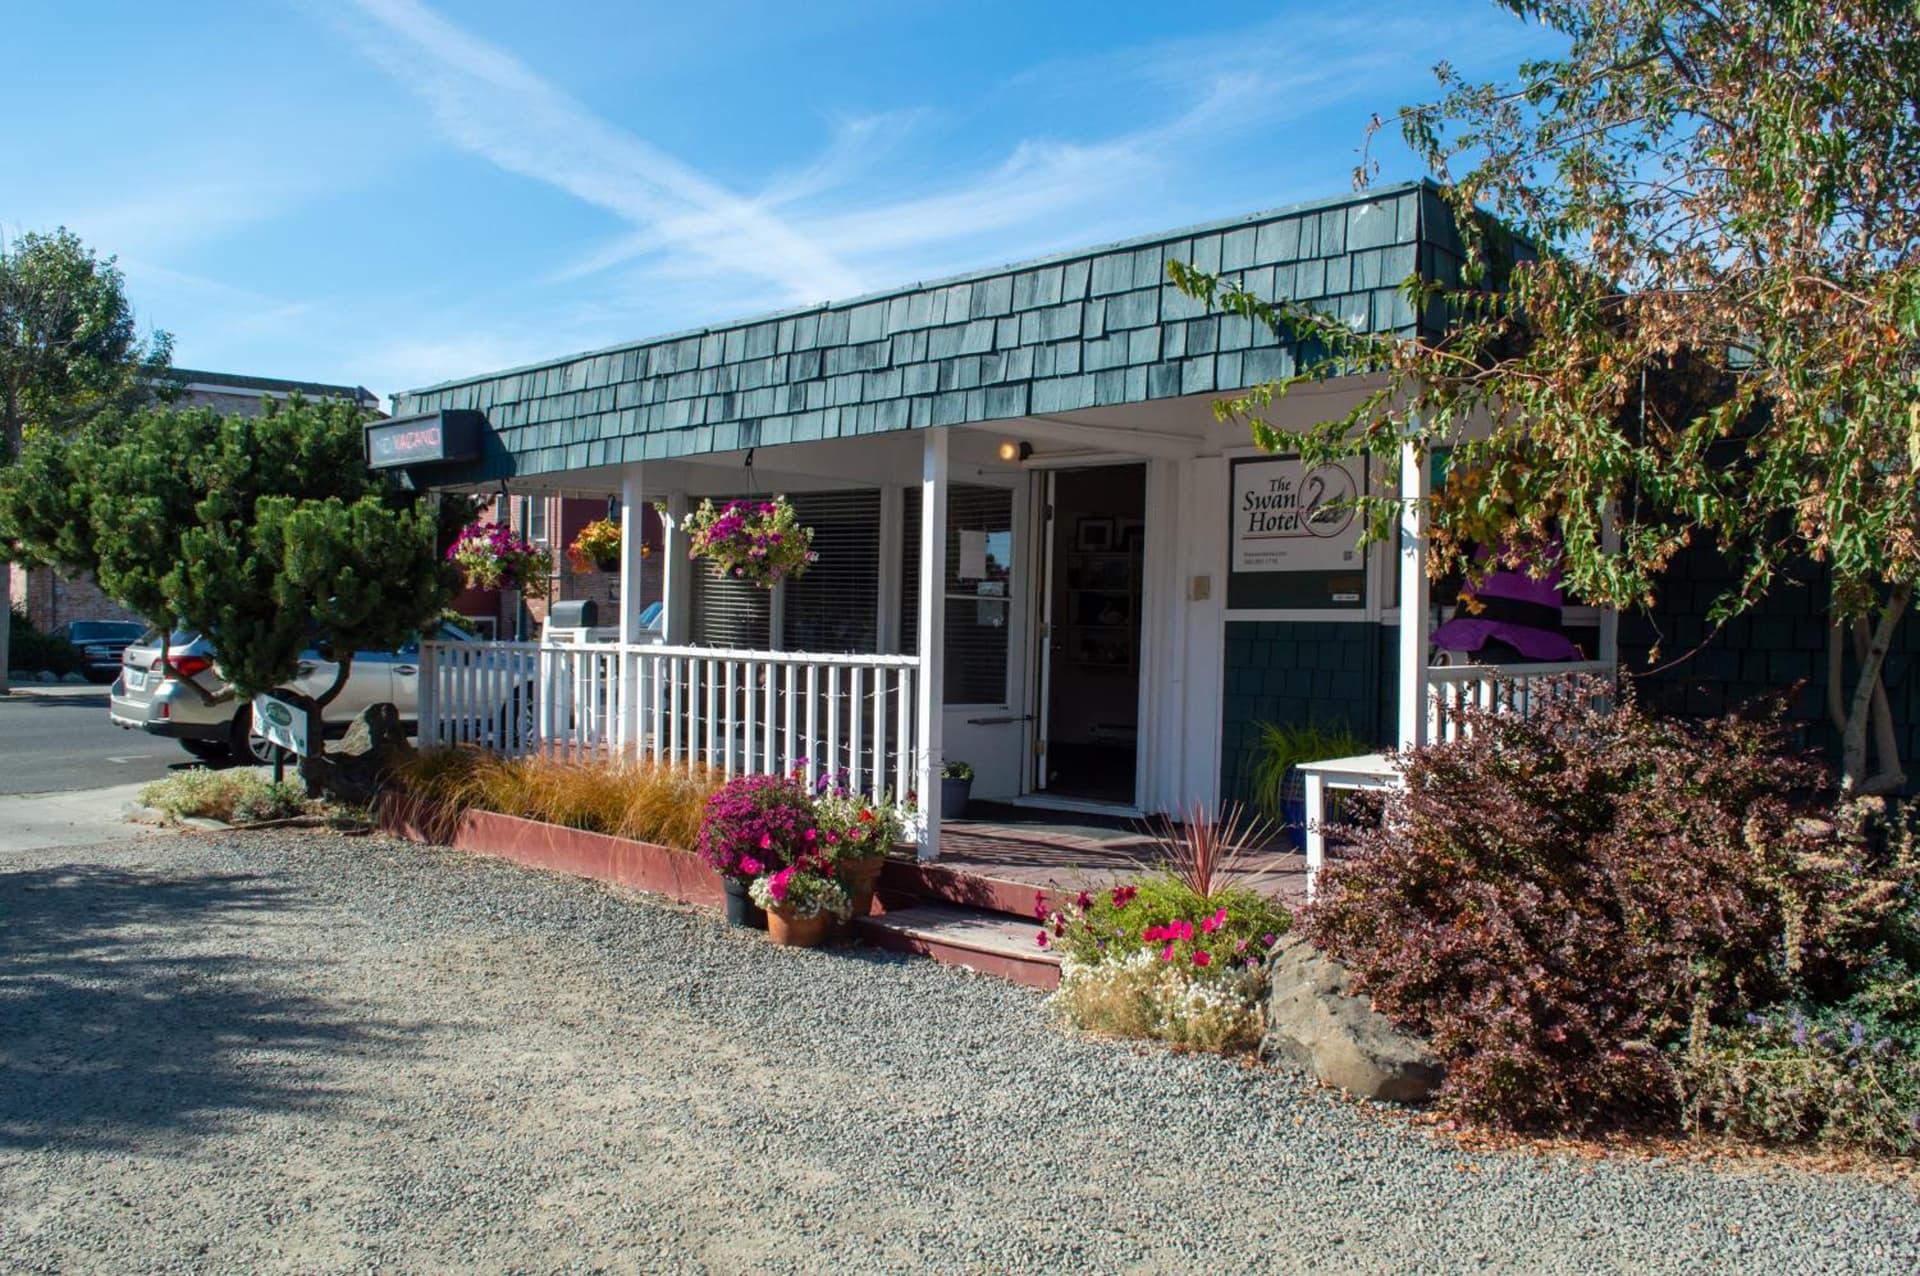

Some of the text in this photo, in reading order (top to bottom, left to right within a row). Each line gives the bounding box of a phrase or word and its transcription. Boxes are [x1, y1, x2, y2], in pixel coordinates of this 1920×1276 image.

[393, 427, 441, 451] VACANC
[1269, 475, 1291, 492] The
[1243, 491, 1296, 511] Swan
[1248, 510, 1300, 532] Hotel
